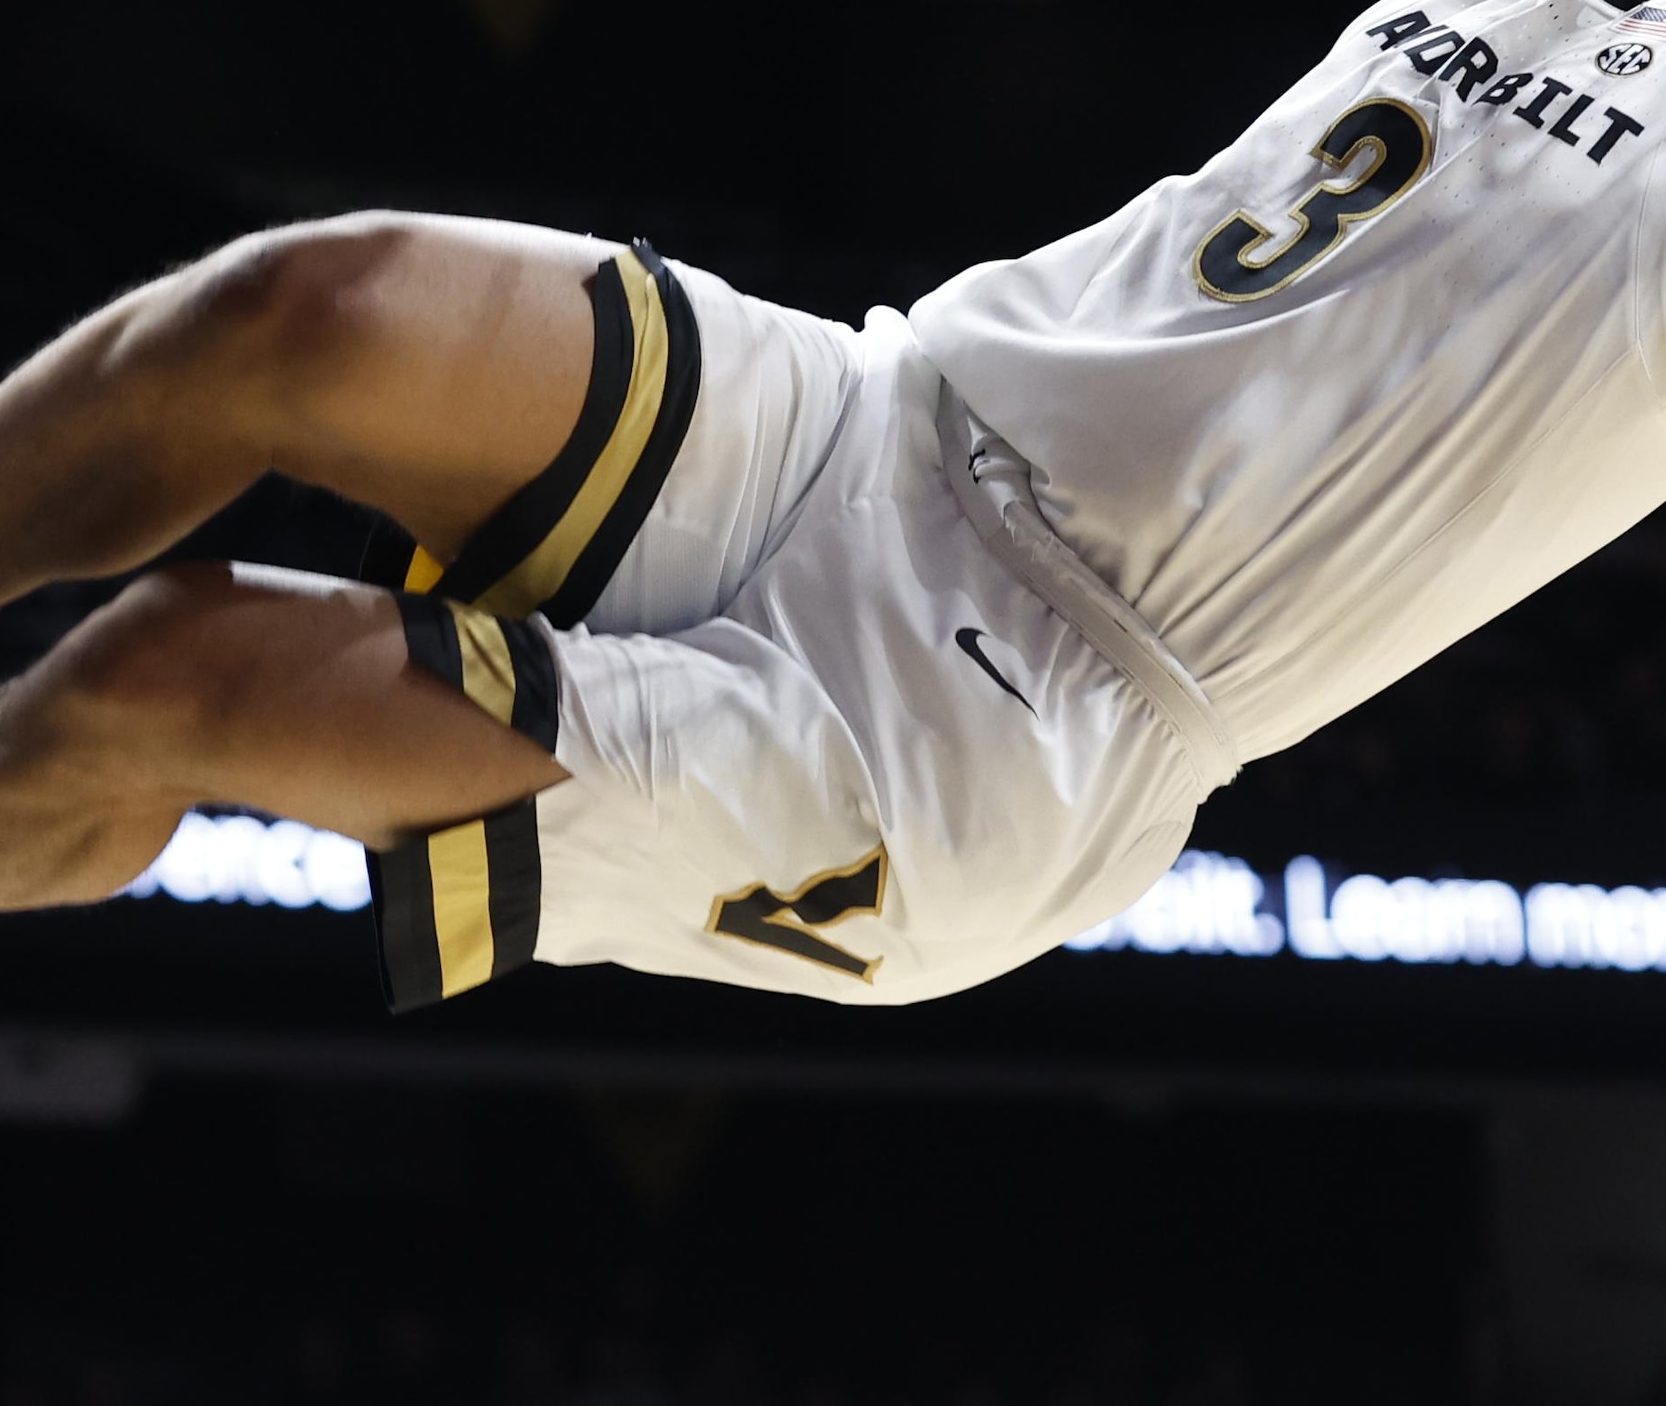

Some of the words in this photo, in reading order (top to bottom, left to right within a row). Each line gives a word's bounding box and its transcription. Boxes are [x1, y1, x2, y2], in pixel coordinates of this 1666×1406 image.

[1596, 43, 1652, 75] SEC
[1194, 97, 1432, 303] 3
[1285, 855, 1526, 965] Learn
